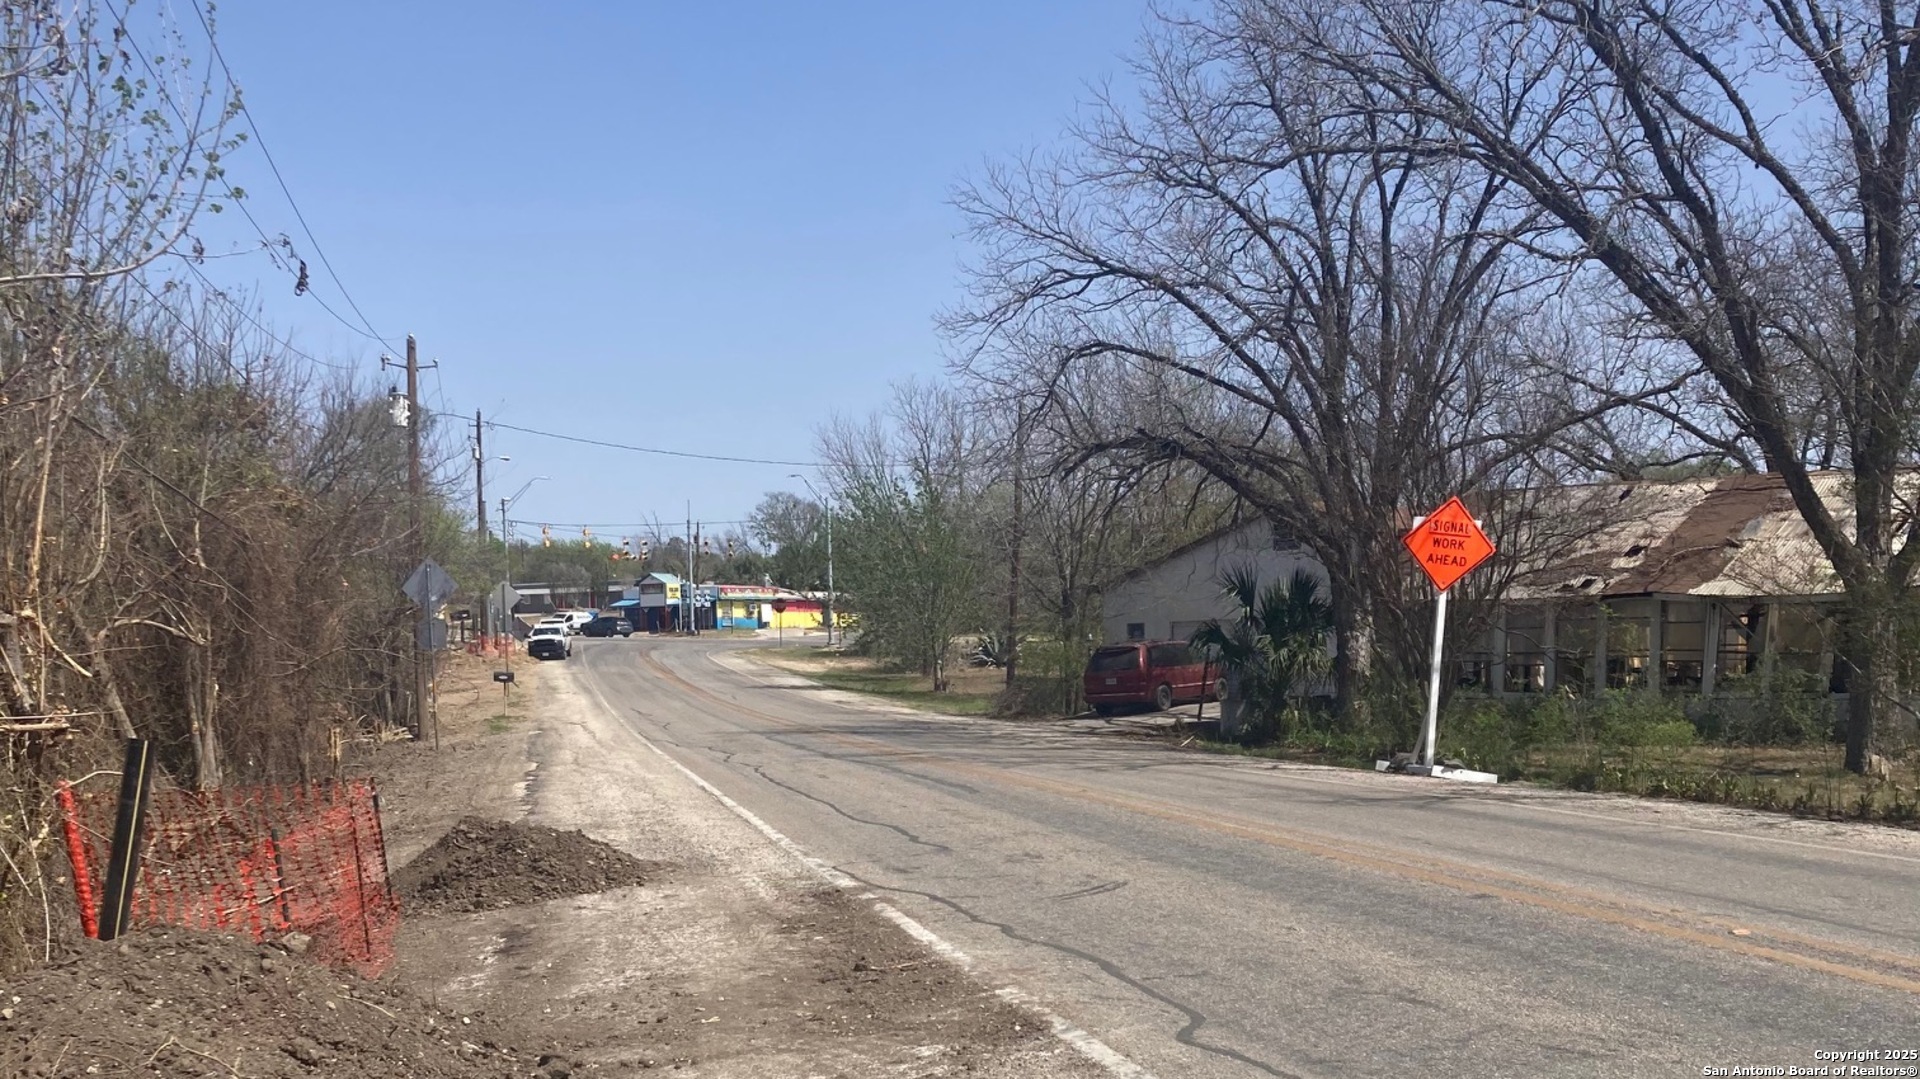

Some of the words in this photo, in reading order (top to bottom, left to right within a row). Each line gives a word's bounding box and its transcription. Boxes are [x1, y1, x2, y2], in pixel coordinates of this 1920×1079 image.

[1434, 520, 1470, 534] SIGNAL
[1432, 537, 1465, 550] WORK
[1426, 553, 1467, 567] AHEAD
